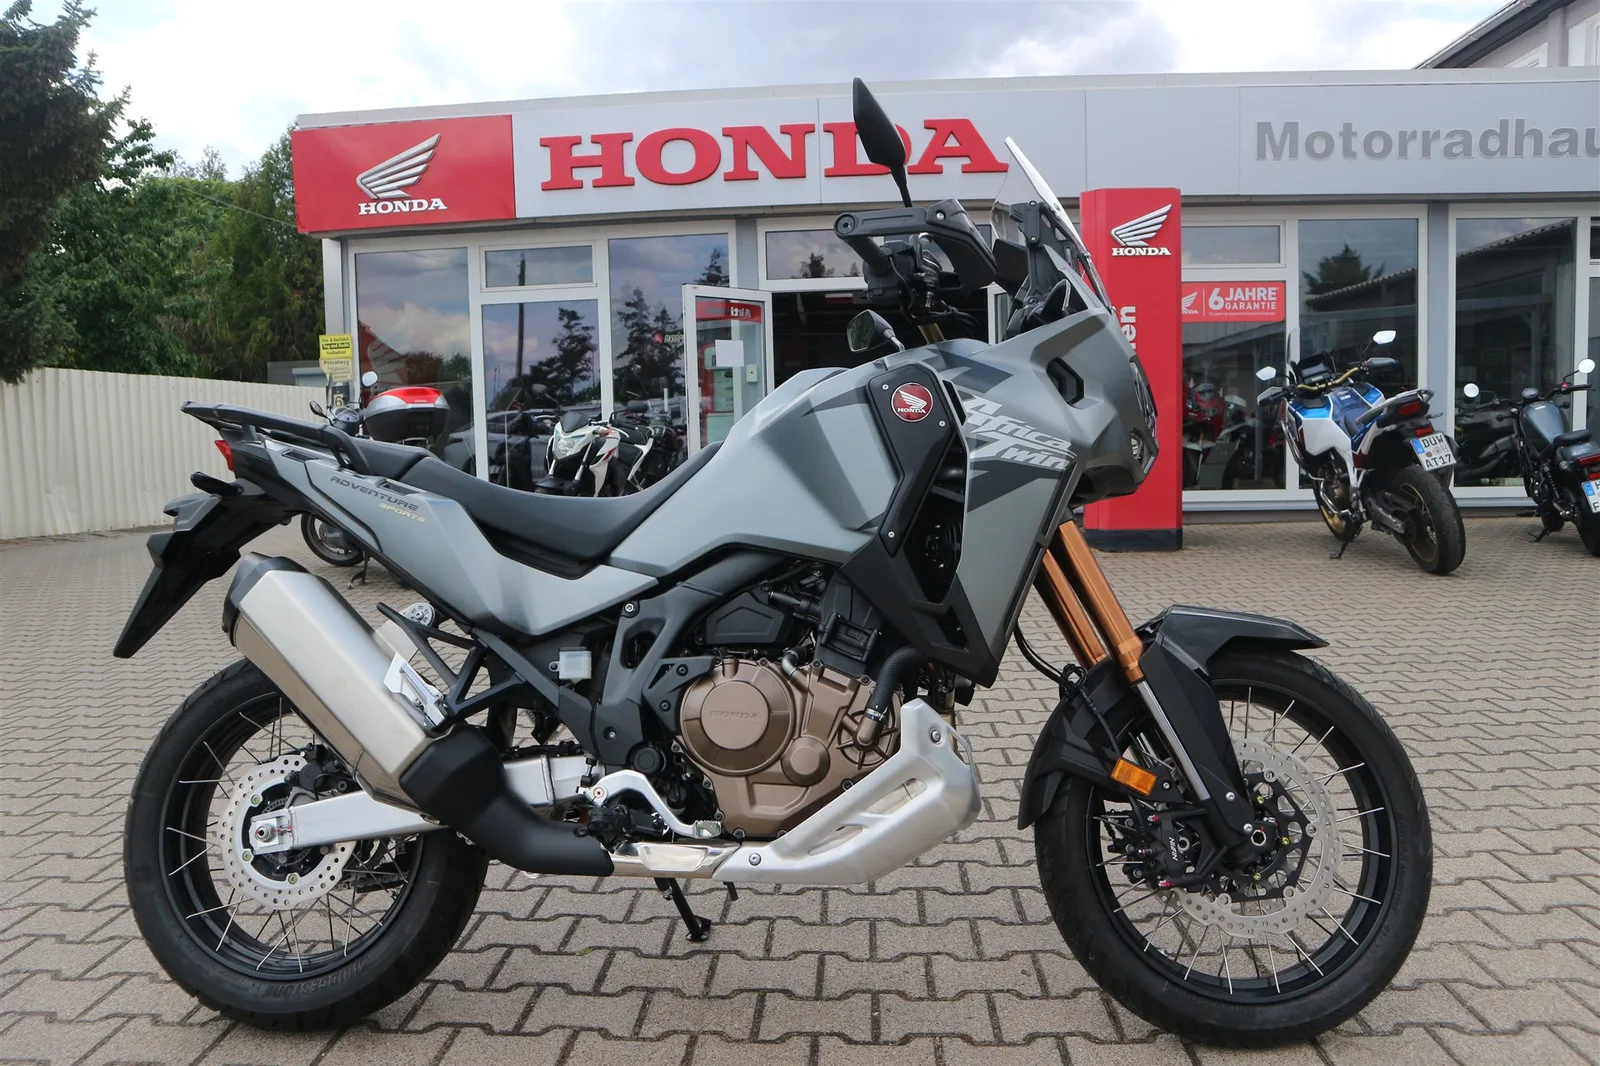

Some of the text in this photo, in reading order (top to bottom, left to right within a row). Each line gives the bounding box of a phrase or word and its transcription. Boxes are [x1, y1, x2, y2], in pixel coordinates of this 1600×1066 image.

[539, 119, 1009, 190] HONDA
[359, 198, 447, 215] HONDA
[1111, 247, 1171, 256] HONDA
[1208, 287, 1225, 310] 6
[1225, 301, 1277, 310] GARANTIE
[1119, 305, 1137, 350] en
[962, 395, 1072, 453] Africa
[969, 432, 1071, 471] Twin
[1425, 453, 1452, 468] AT17
[330, 476, 419, 511] ADVENTURE
[379, 502, 426, 523] SPORTS
[709, 709, 760, 721] HONDA
